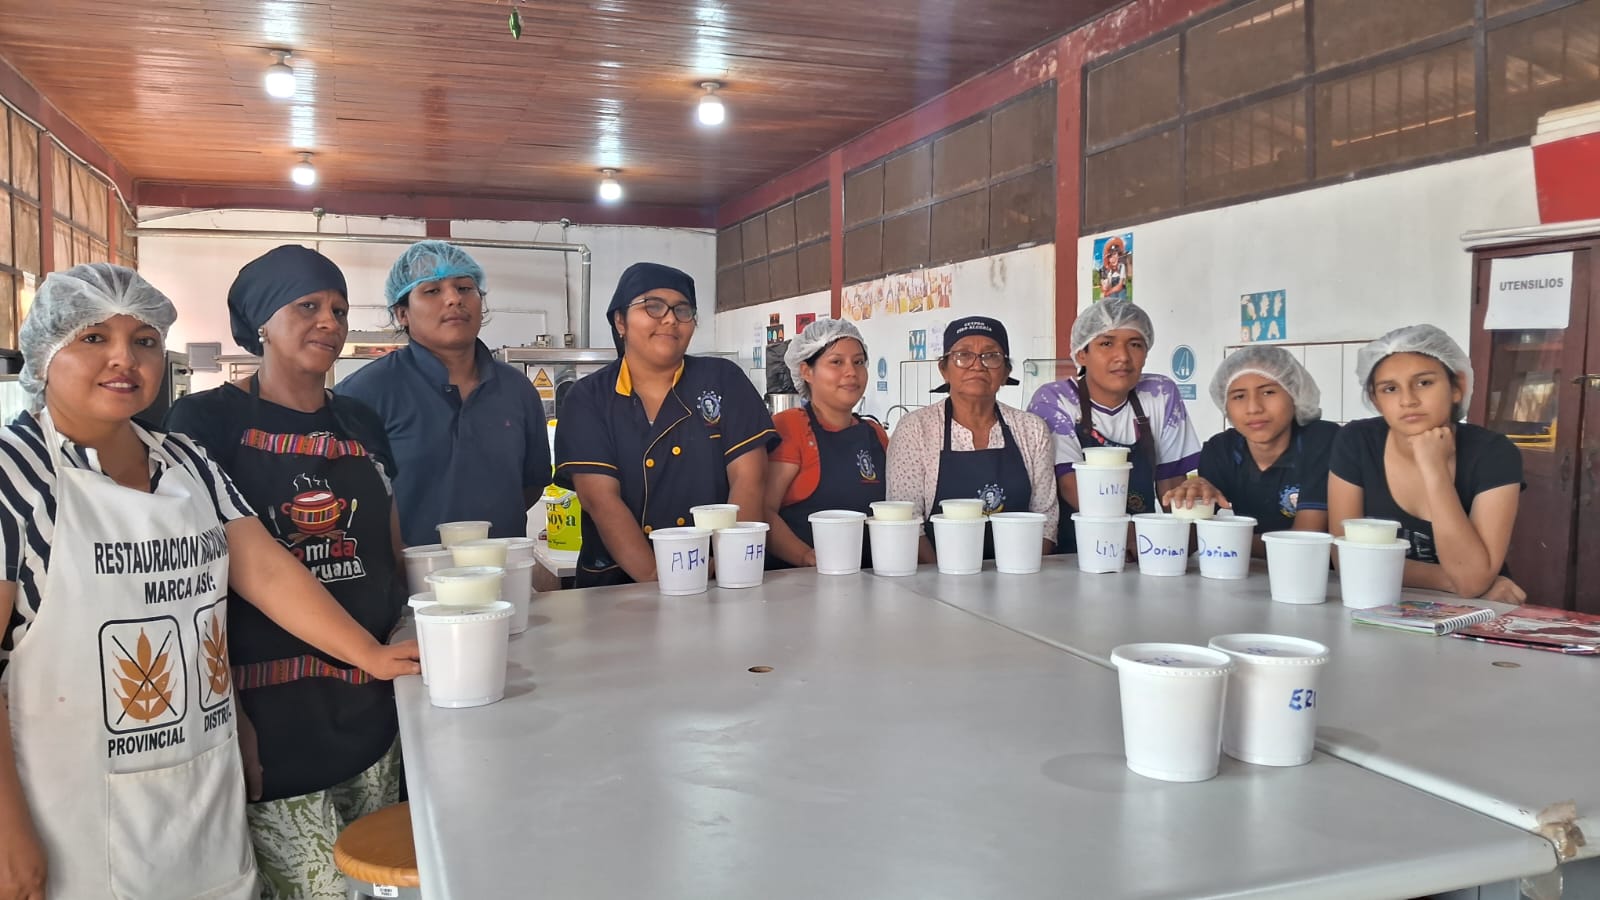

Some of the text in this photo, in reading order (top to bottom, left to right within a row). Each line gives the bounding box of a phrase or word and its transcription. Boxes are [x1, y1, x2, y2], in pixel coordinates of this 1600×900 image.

[1499, 277, 1564, 291] UTENSILIOS
[94, 535, 199, 575] RESTAURACION
[290, 532, 355, 561] omida
[1138, 534, 1185, 556] Dorian
[311, 560, 362, 579] ruana
[144, 577, 193, 605] MARCA
[107, 726, 186, 759] PROVINCIAL
